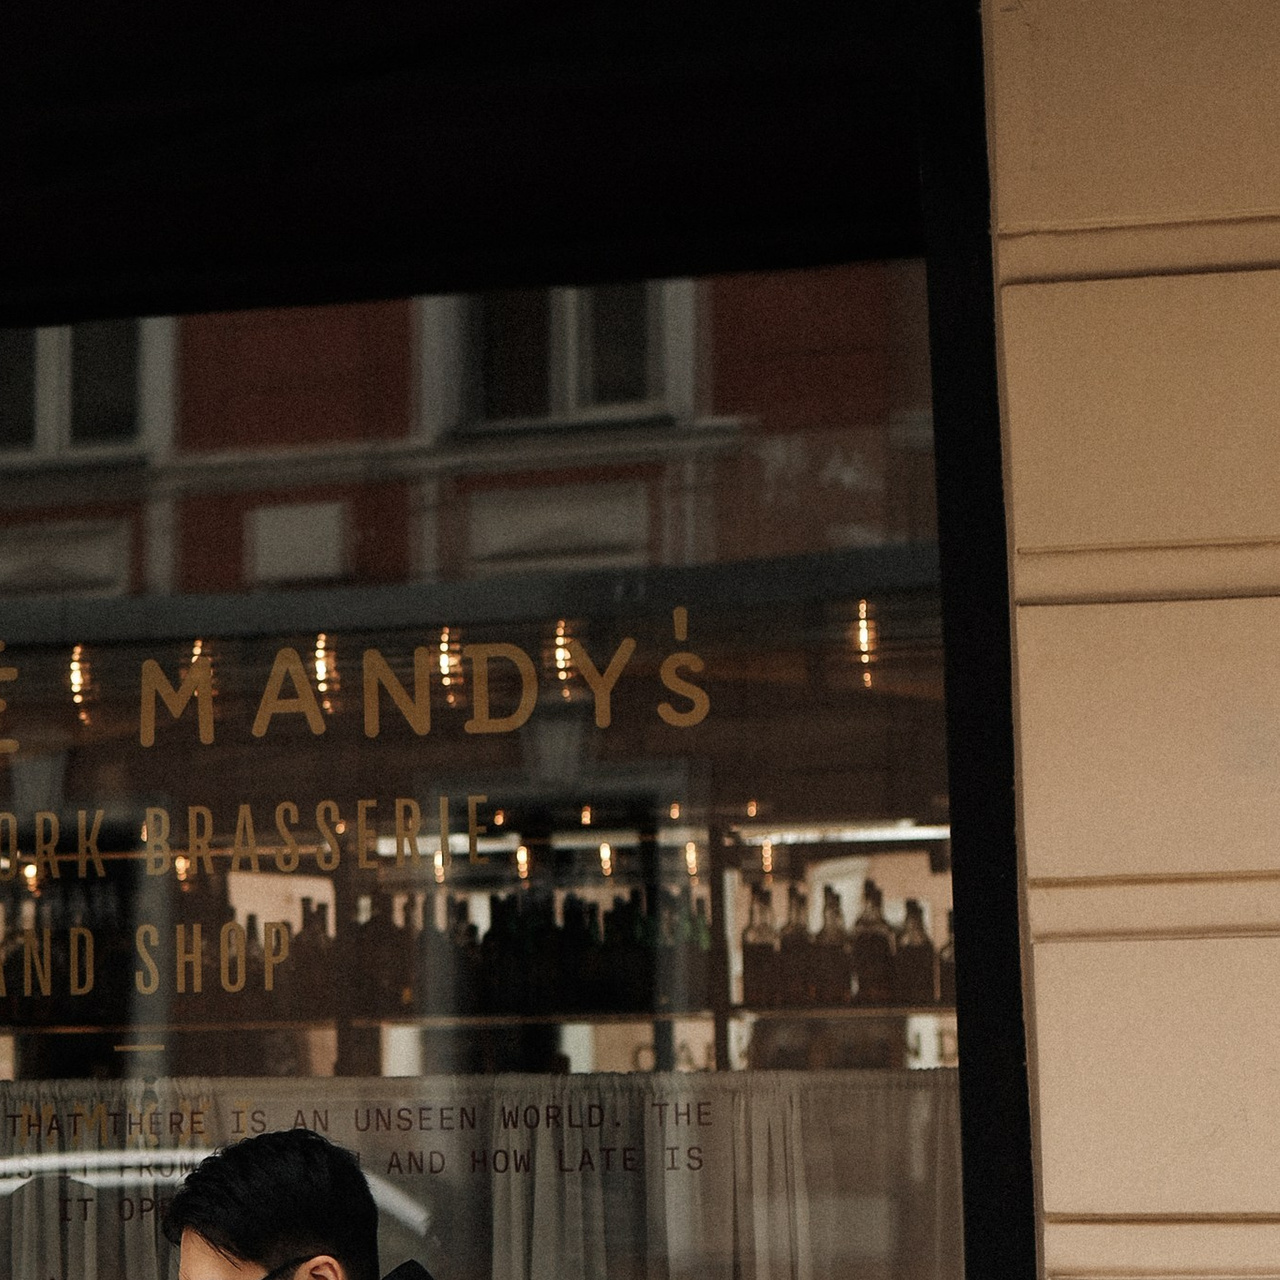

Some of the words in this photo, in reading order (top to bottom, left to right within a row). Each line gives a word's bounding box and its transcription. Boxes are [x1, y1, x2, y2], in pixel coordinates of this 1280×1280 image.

[145, 795, 490, 877] BRASSERIE
[135, 920, 290, 996] SHOP
[6, 1113, 83, 1138] THAT
[107, 1111, 205, 1136] THERE
[231, 1109, 267, 1134] IS
[293, 1108, 329, 1132] AN
[355, 1106, 477, 1133] UNSEEN
[502, 1103, 622, 1131] WORLD.
[651, 1101, 713, 1127] THE
[387, 1150, 446, 1175] AND
[471, 1149, 531, 1174] HOW
[558, 1147, 637, 1172] LATE
[666, 1146, 704, 1172] IS
[59, 1197, 94, 1222] IT
